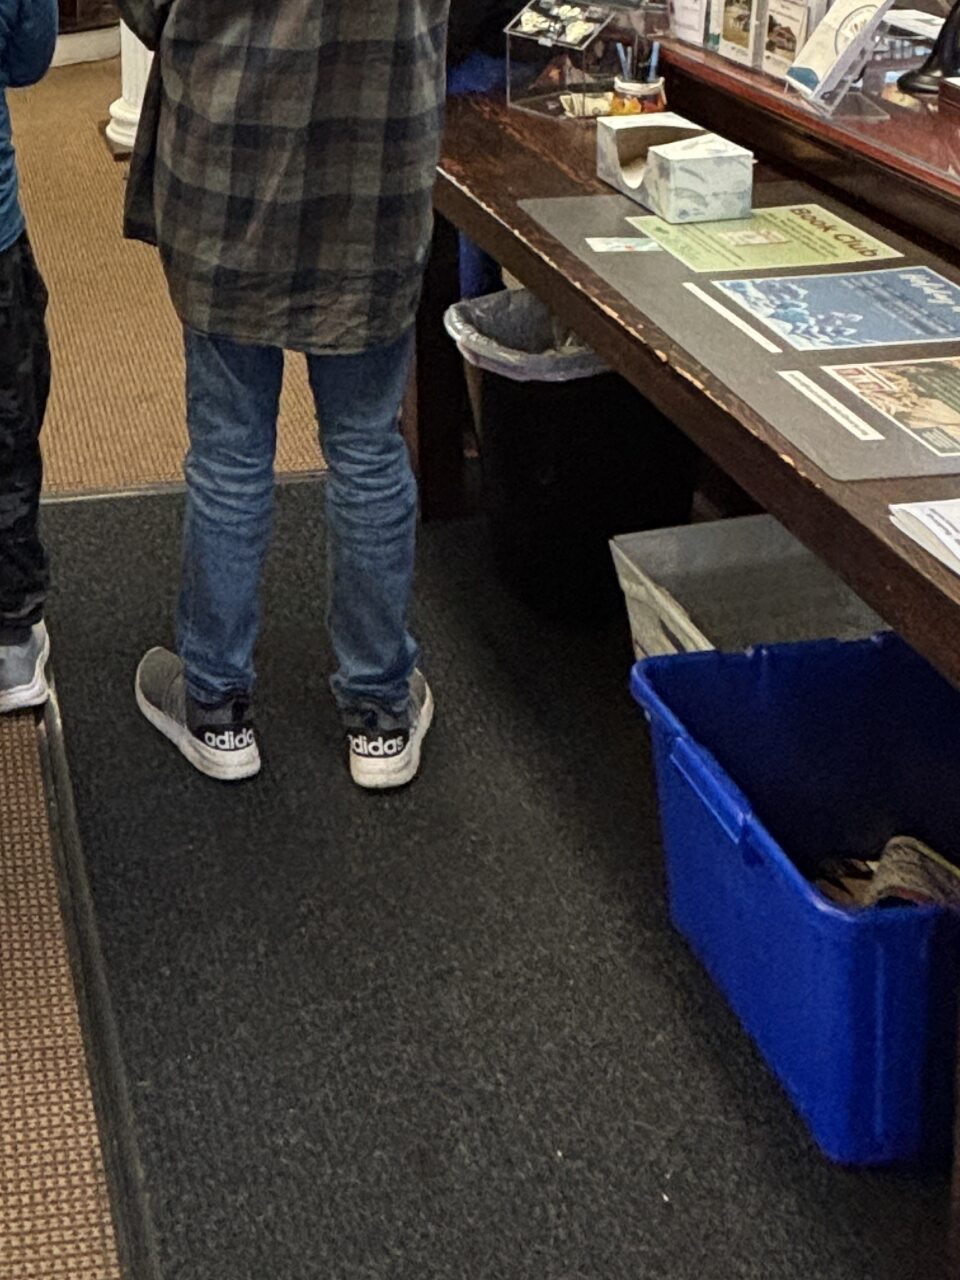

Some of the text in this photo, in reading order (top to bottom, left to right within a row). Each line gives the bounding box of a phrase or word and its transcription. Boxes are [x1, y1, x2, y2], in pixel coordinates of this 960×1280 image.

[790, 207, 837, 233] Book
[834, 233, 878, 257] Club
[204, 728, 254, 750] adida
